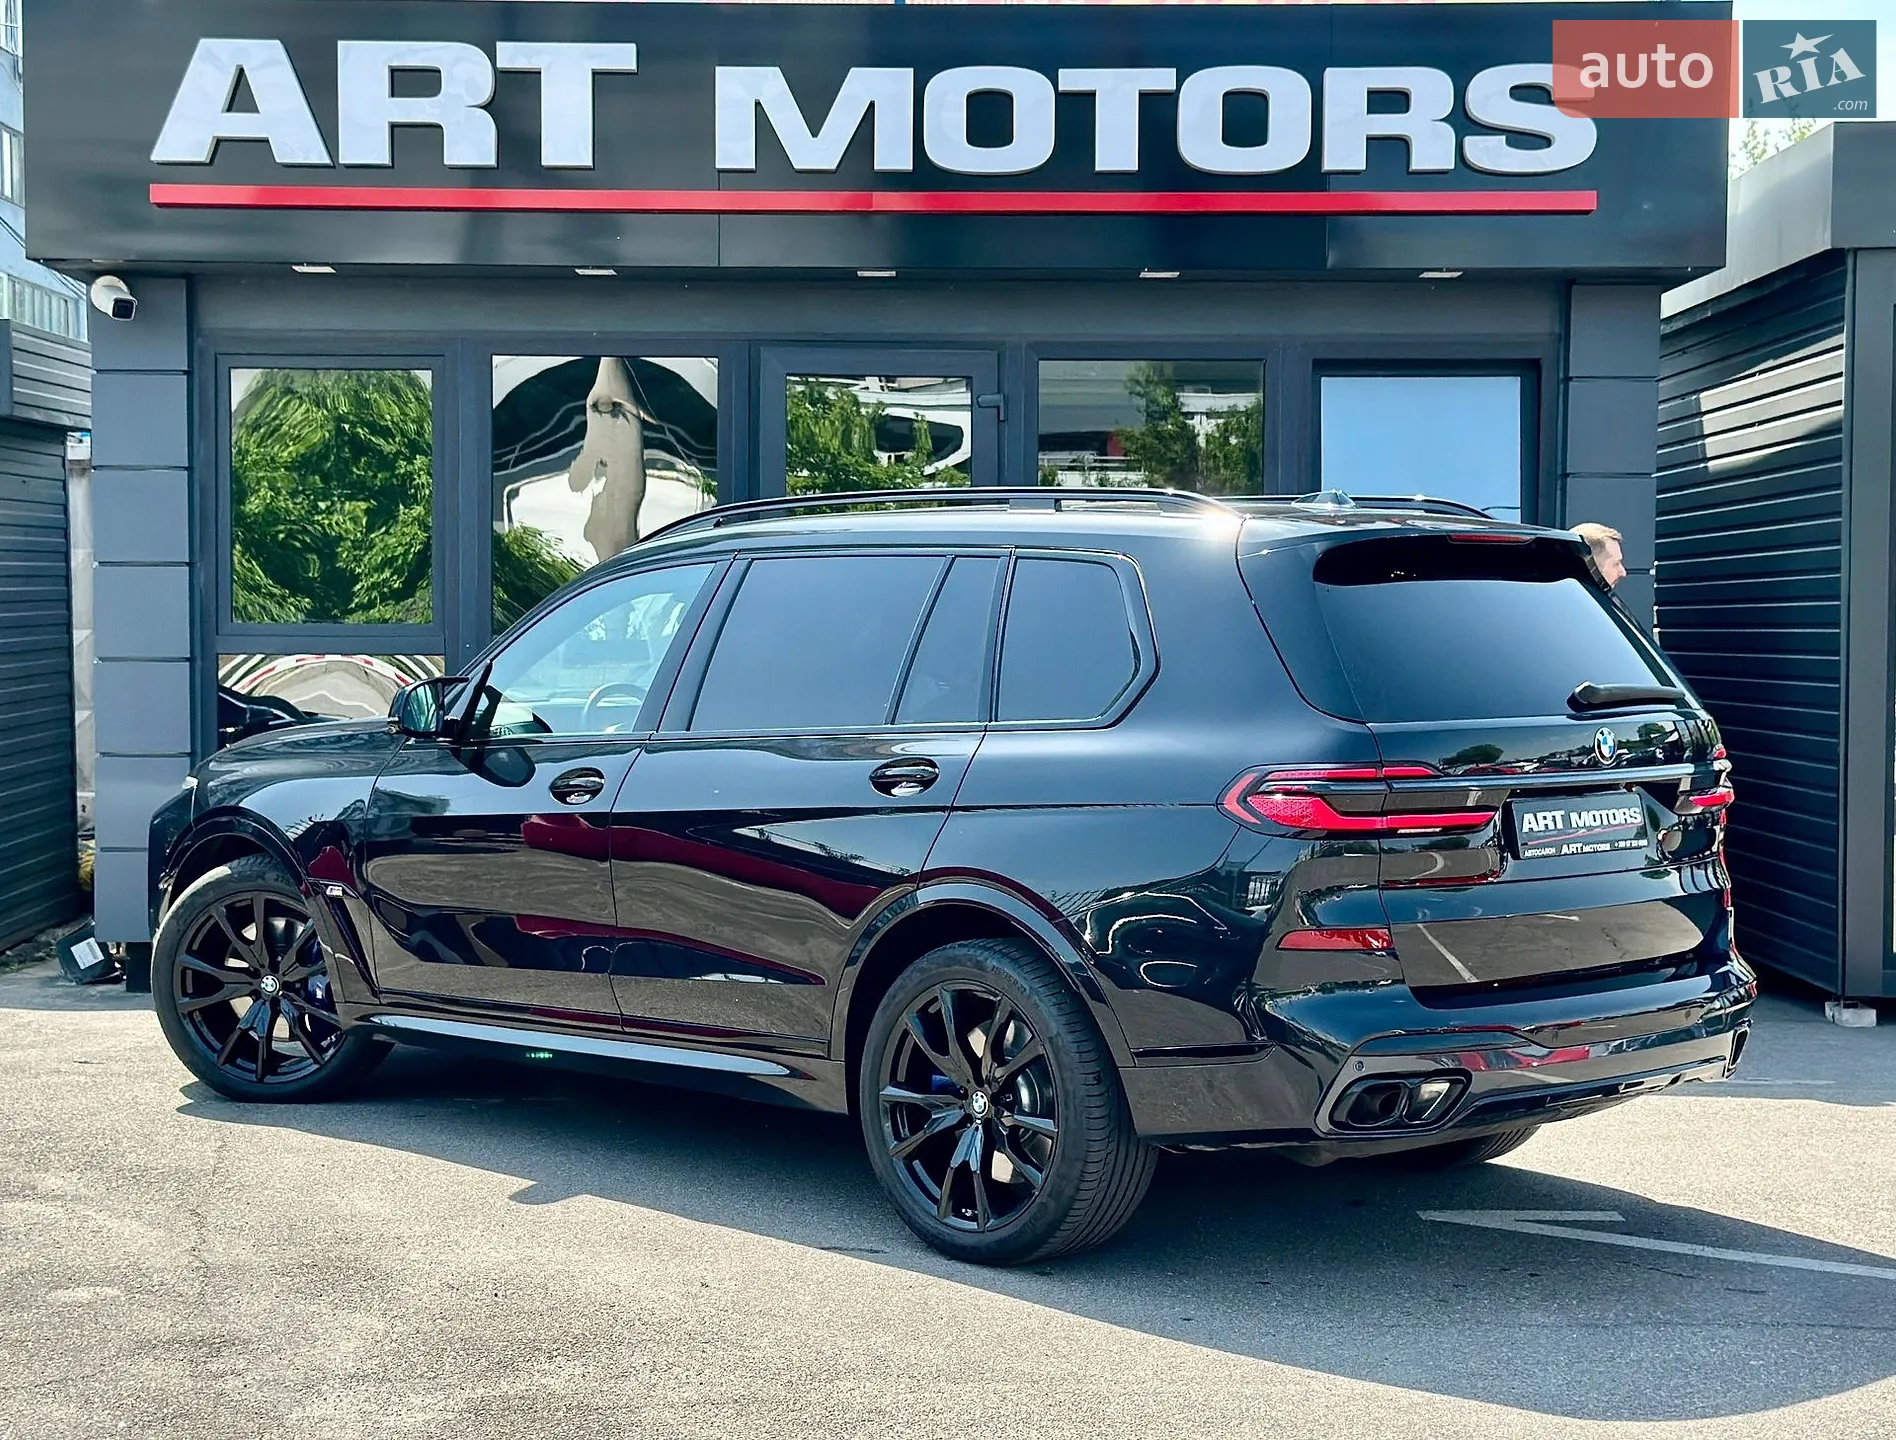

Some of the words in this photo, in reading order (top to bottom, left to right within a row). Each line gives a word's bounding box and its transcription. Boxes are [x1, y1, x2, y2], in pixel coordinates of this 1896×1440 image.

[149, 38, 638, 169] ART
[715, 63, 1598, 176] MOTORS
[1521, 810, 1566, 833] ART
[1569, 807, 1643, 828] MOTORS
[1560, 842, 1583, 854] ART
